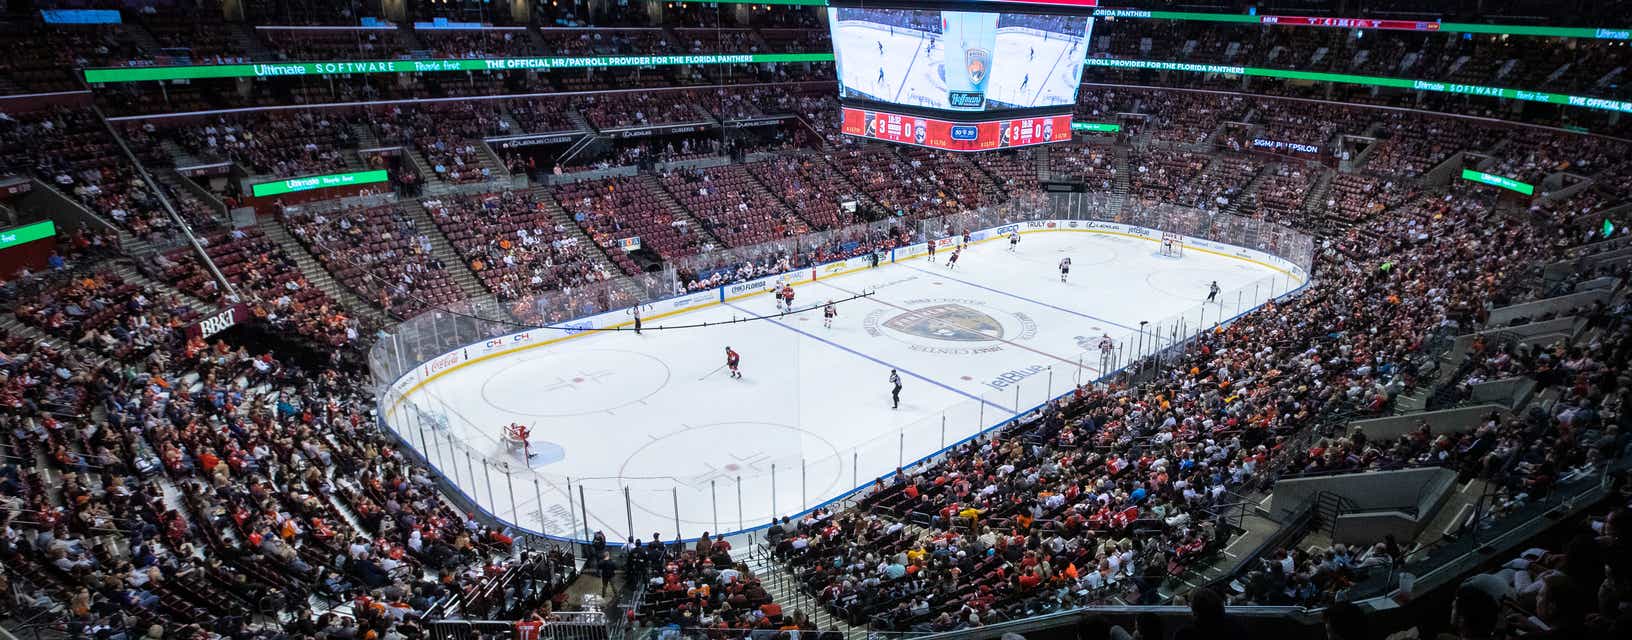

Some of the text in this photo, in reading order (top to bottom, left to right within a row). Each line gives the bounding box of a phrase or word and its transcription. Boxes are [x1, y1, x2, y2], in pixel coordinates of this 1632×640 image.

[1092, 9, 1150, 18] ORIDA PANTHERS
[485, 54, 753, 69] THE OFFICIAL HR/PAYROLL PROVIDER FOR THE FLORIDA PANTHERS
[1110, 60, 1146, 68] PROVIDER
[1147, 61, 1161, 69] FOR
[1163, 62, 1176, 70] THE
[1177, 62, 1207, 71] FLORIDA
[1208, 64, 1244, 74] PANTHERS
[253, 62, 395, 76] Ultimate SOFTWARE
[1450, 83, 1504, 97] SOFTWARE
[1568, 96, 1586, 106] THE
[1587, 98, 1619, 110] OFFICIAL
[879, 119, 886, 134] 3
[904, 122, 912, 137] 0
[1013, 125, 1020, 140] 3
[1035, 124, 1041, 138] 0
[996, 224, 1019, 235] GEICO
[1027, 221, 1045, 229] TRULY
[625, 304, 655, 316] CTS
[983, 364, 1044, 391] jetBlue
